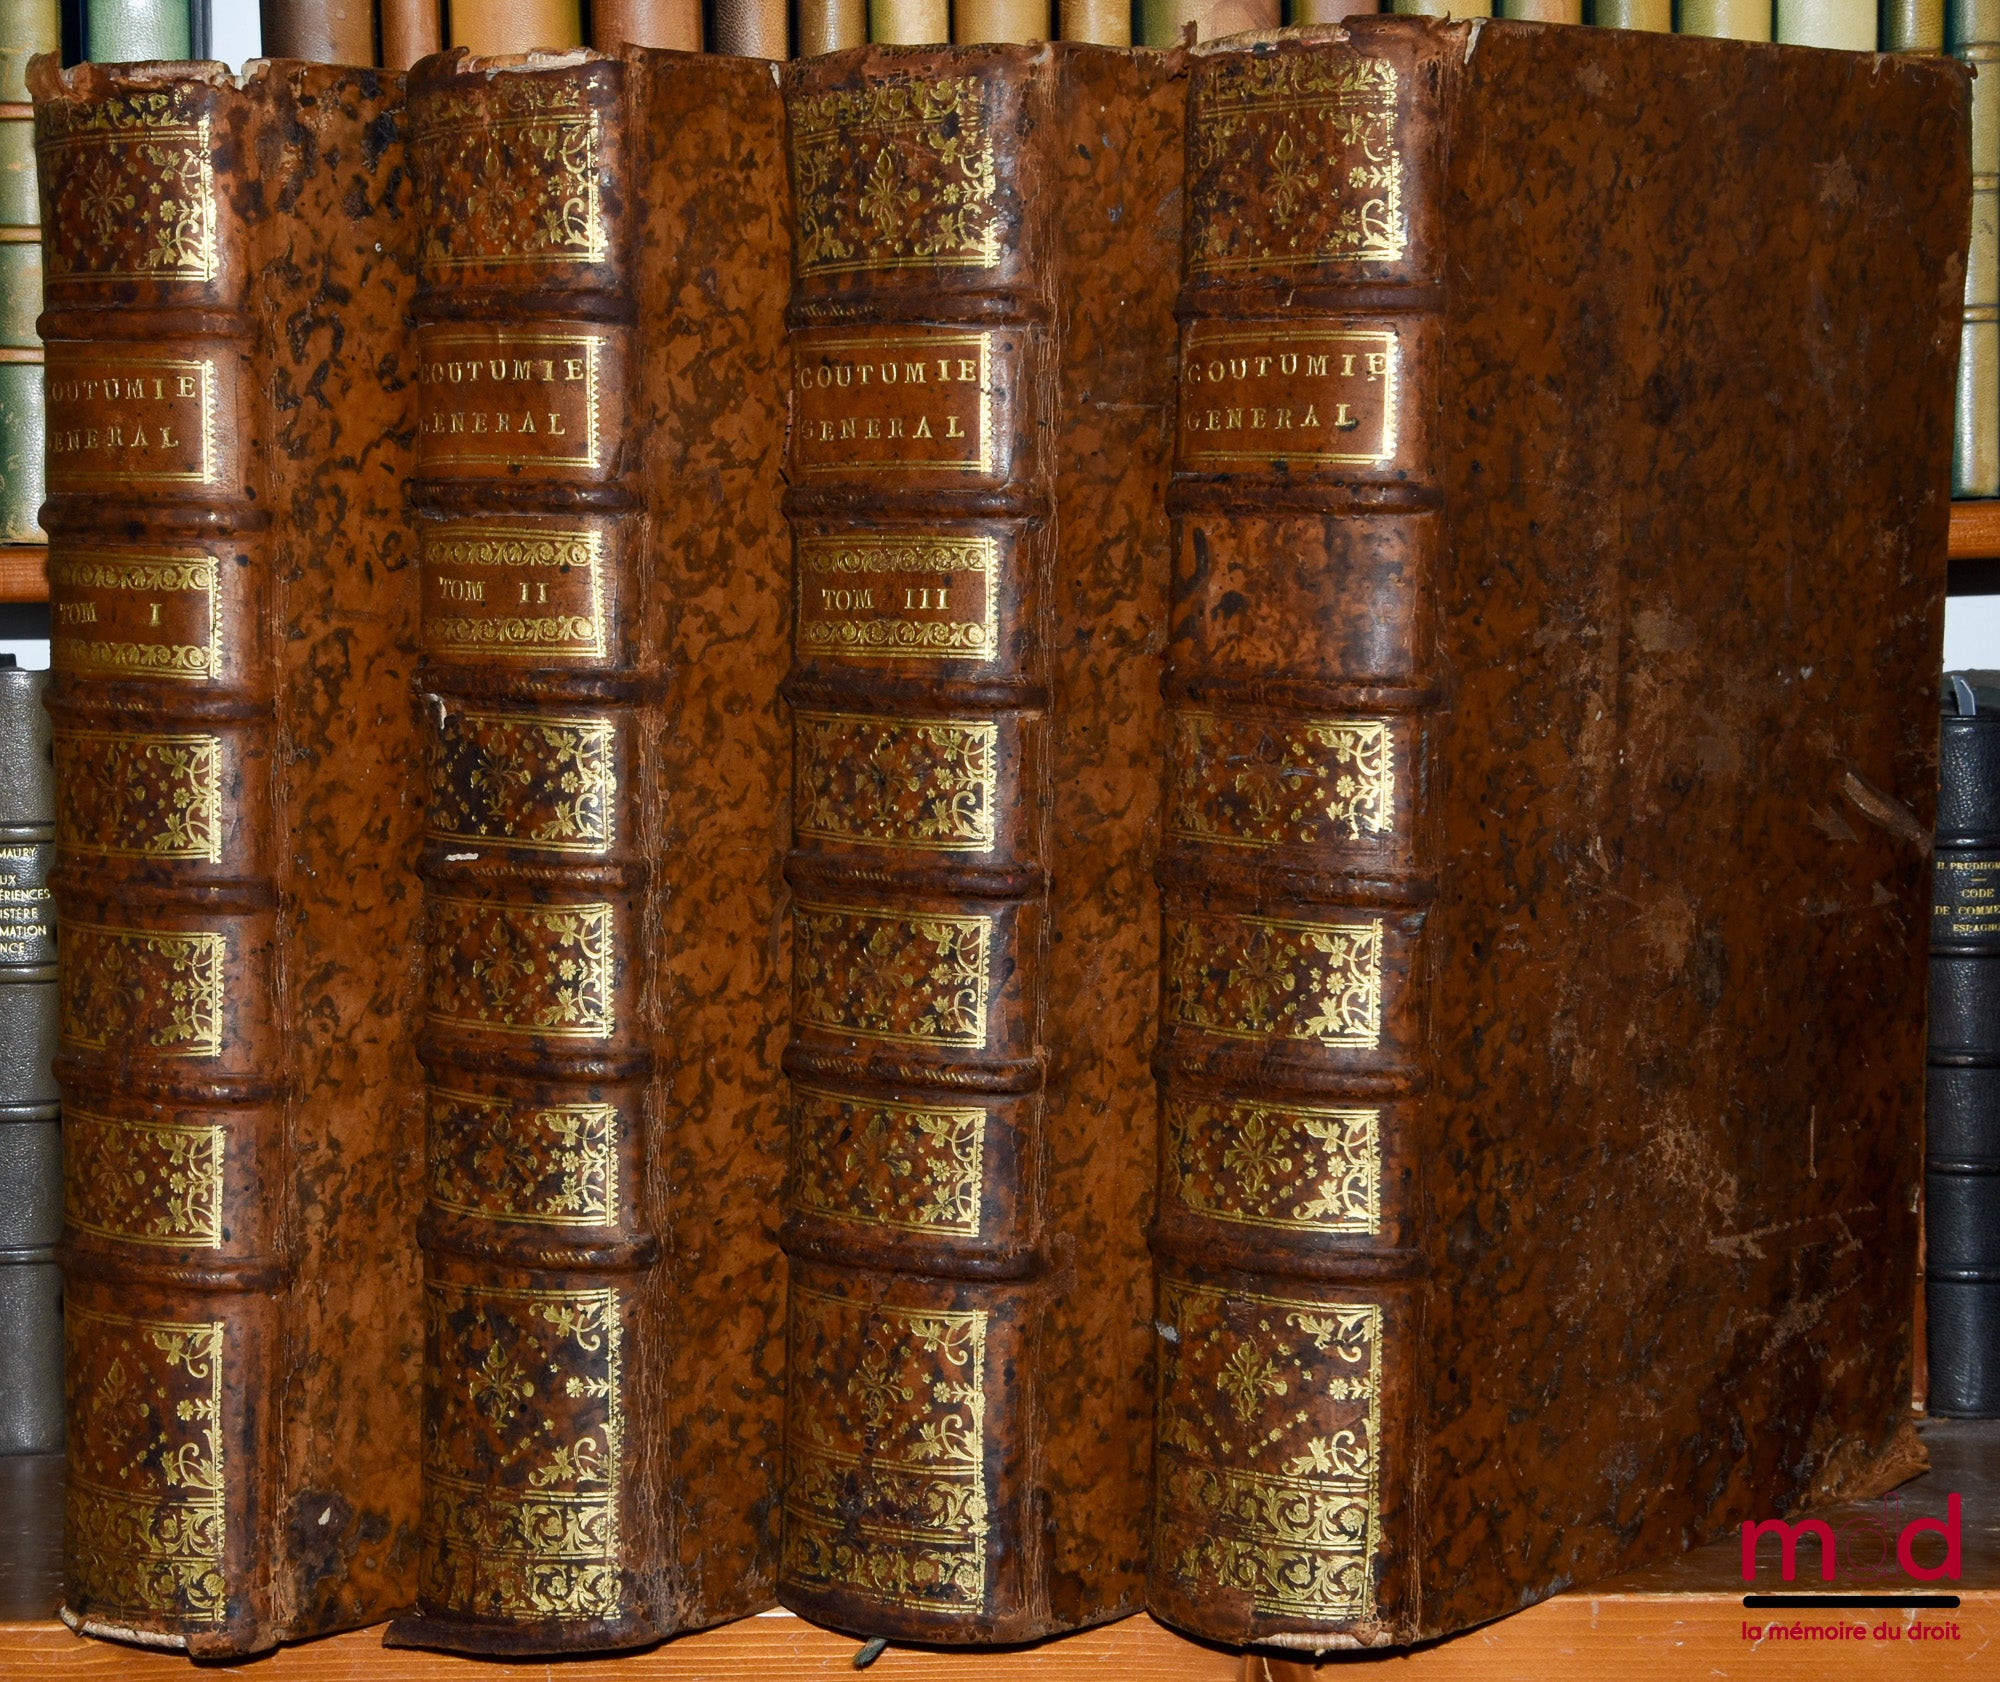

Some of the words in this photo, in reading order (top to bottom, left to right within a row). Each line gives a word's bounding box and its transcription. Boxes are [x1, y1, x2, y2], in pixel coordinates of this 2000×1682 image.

[421, 358, 584, 384] COUTUMIE
[800, 359, 977, 389] COUTUMIE
[1188, 353, 1386, 385] COUTUMIE
[48, 376, 196, 401] OUTUMIE
[420, 411, 566, 435] GENERAL
[802, 415, 965, 441] GENERAL
[1187, 403, 1358, 432] GENERAL
[439, 577, 486, 601] TOM
[519, 582, 550, 604] II
[822, 588, 875, 611] TOM
[904, 588, 950, 610] III
[60, 602, 98, 625] TOM
[150, 603, 162, 627] I
[1961, 888, 1995, 898] CODE
[1934, 905, 1951, 915] DE
